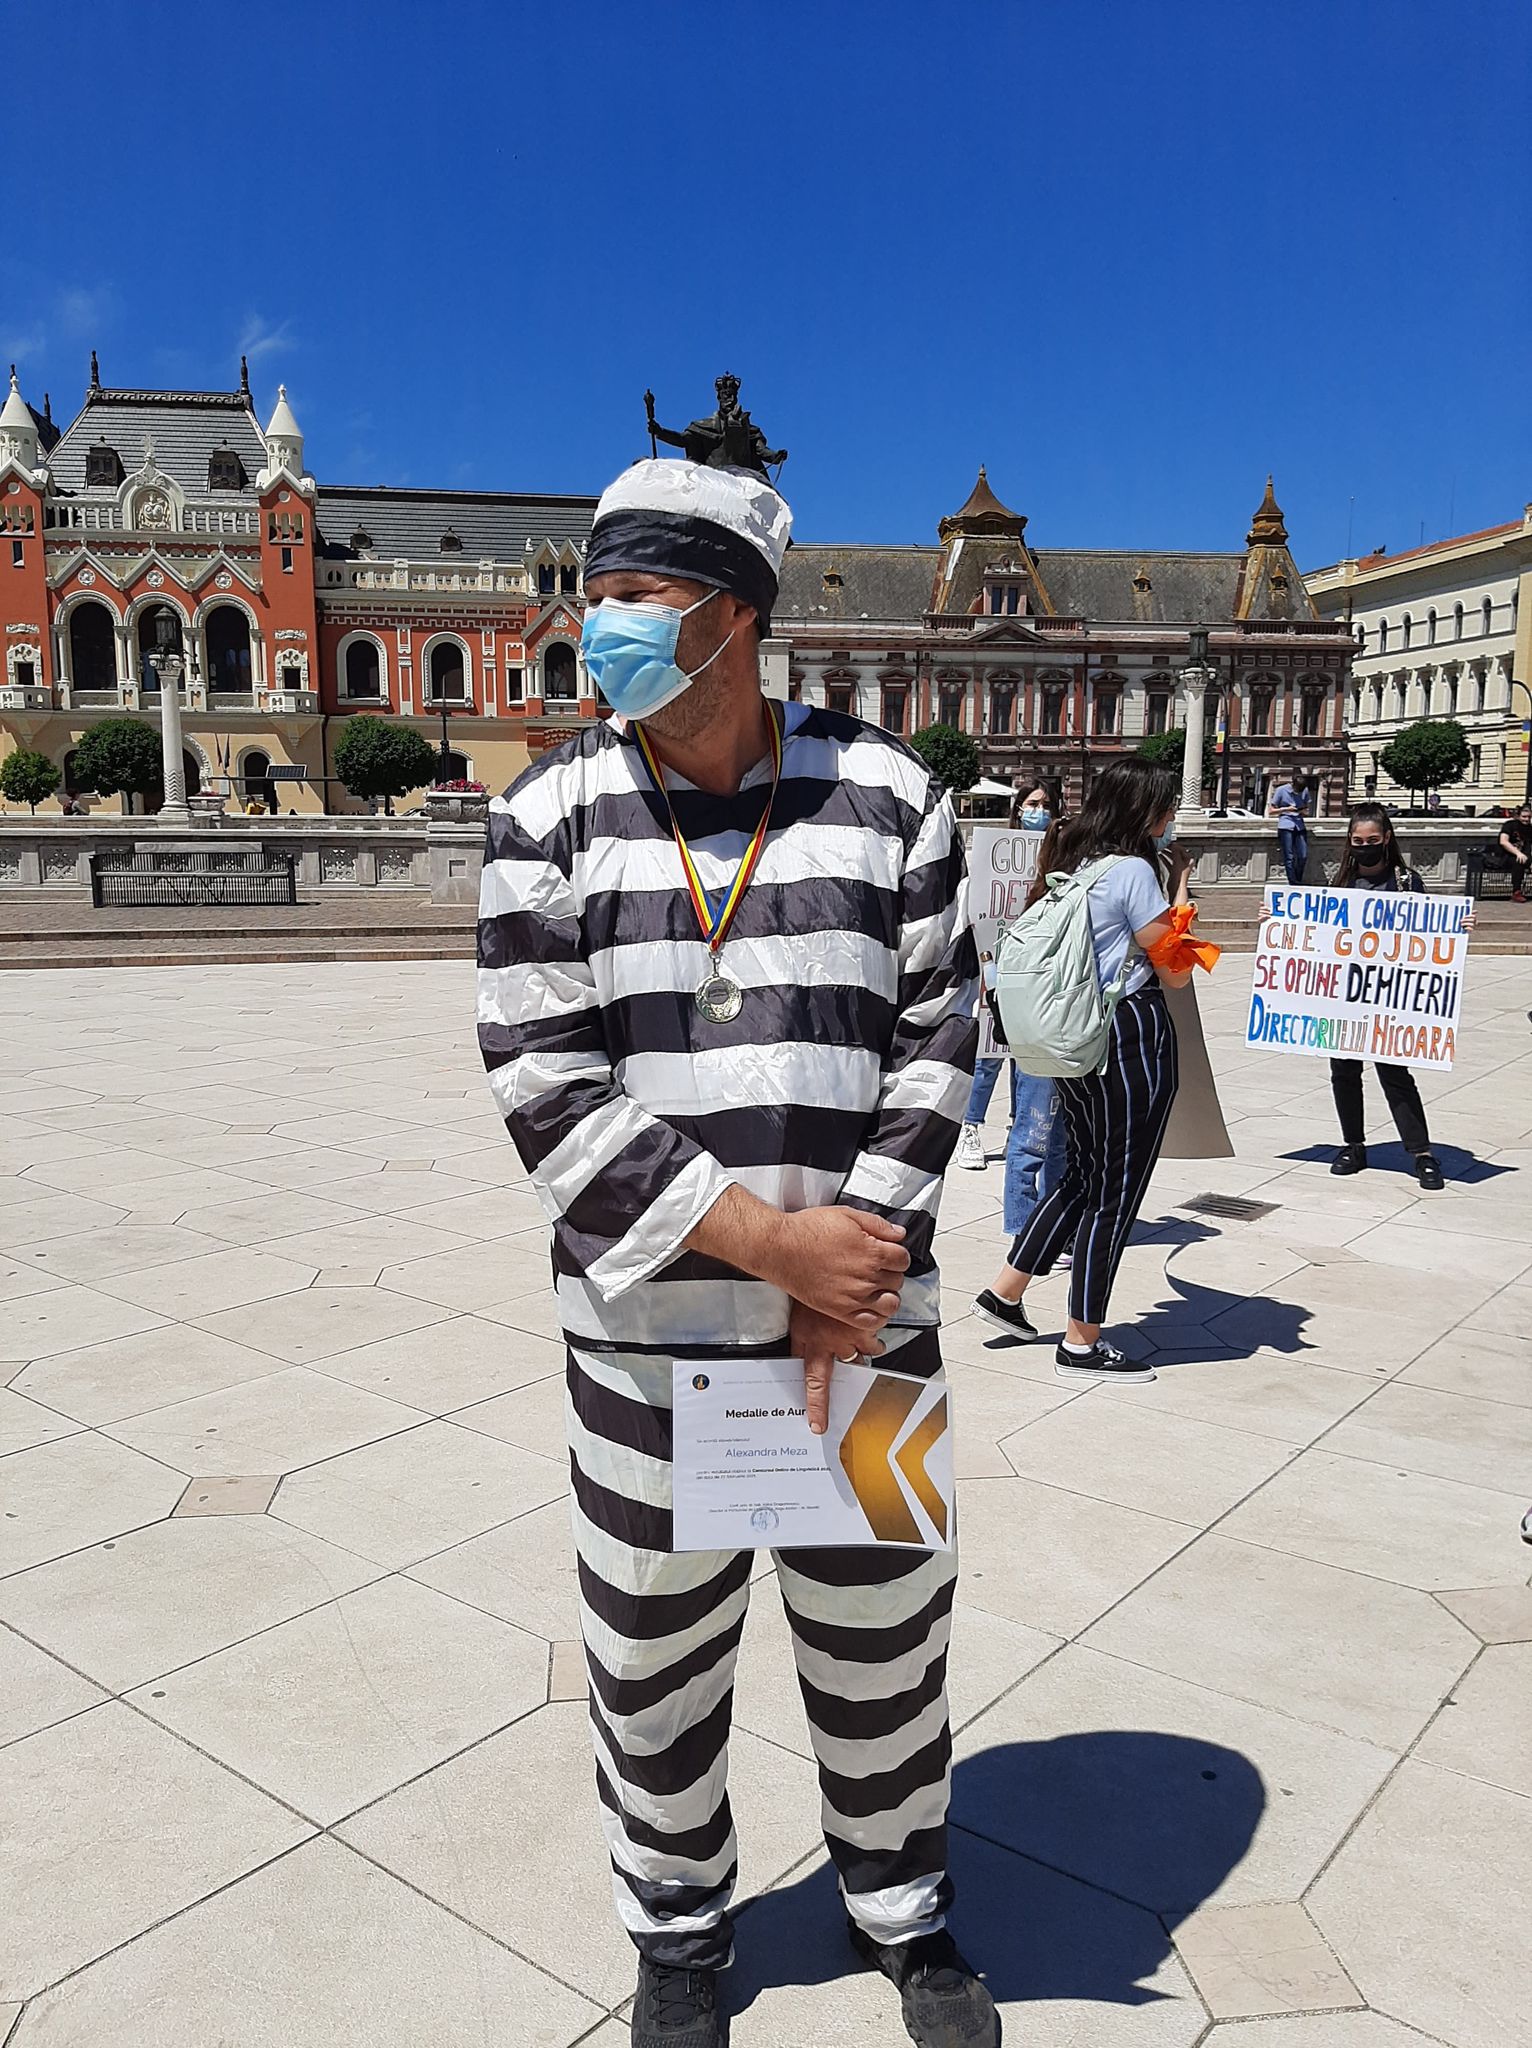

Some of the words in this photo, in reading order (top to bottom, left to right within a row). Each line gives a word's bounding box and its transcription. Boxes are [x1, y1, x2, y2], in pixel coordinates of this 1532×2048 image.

[1271, 889, 1349, 927] ECHIPA
[1334, 929, 1455, 965] GOJDU
[1254, 954, 1281, 990] SE
[1284, 957, 1343, 999] OPUNE
[1345, 963, 1459, 1019] DEMITERII
[1371, 1014, 1455, 1063] NICOARA
[725, 1408, 769, 1419] Medalie
[771, 1408, 785, 1417] de
[725, 1448, 777, 1458] Alexandra
[780, 1447, 808, 1456] Meza
